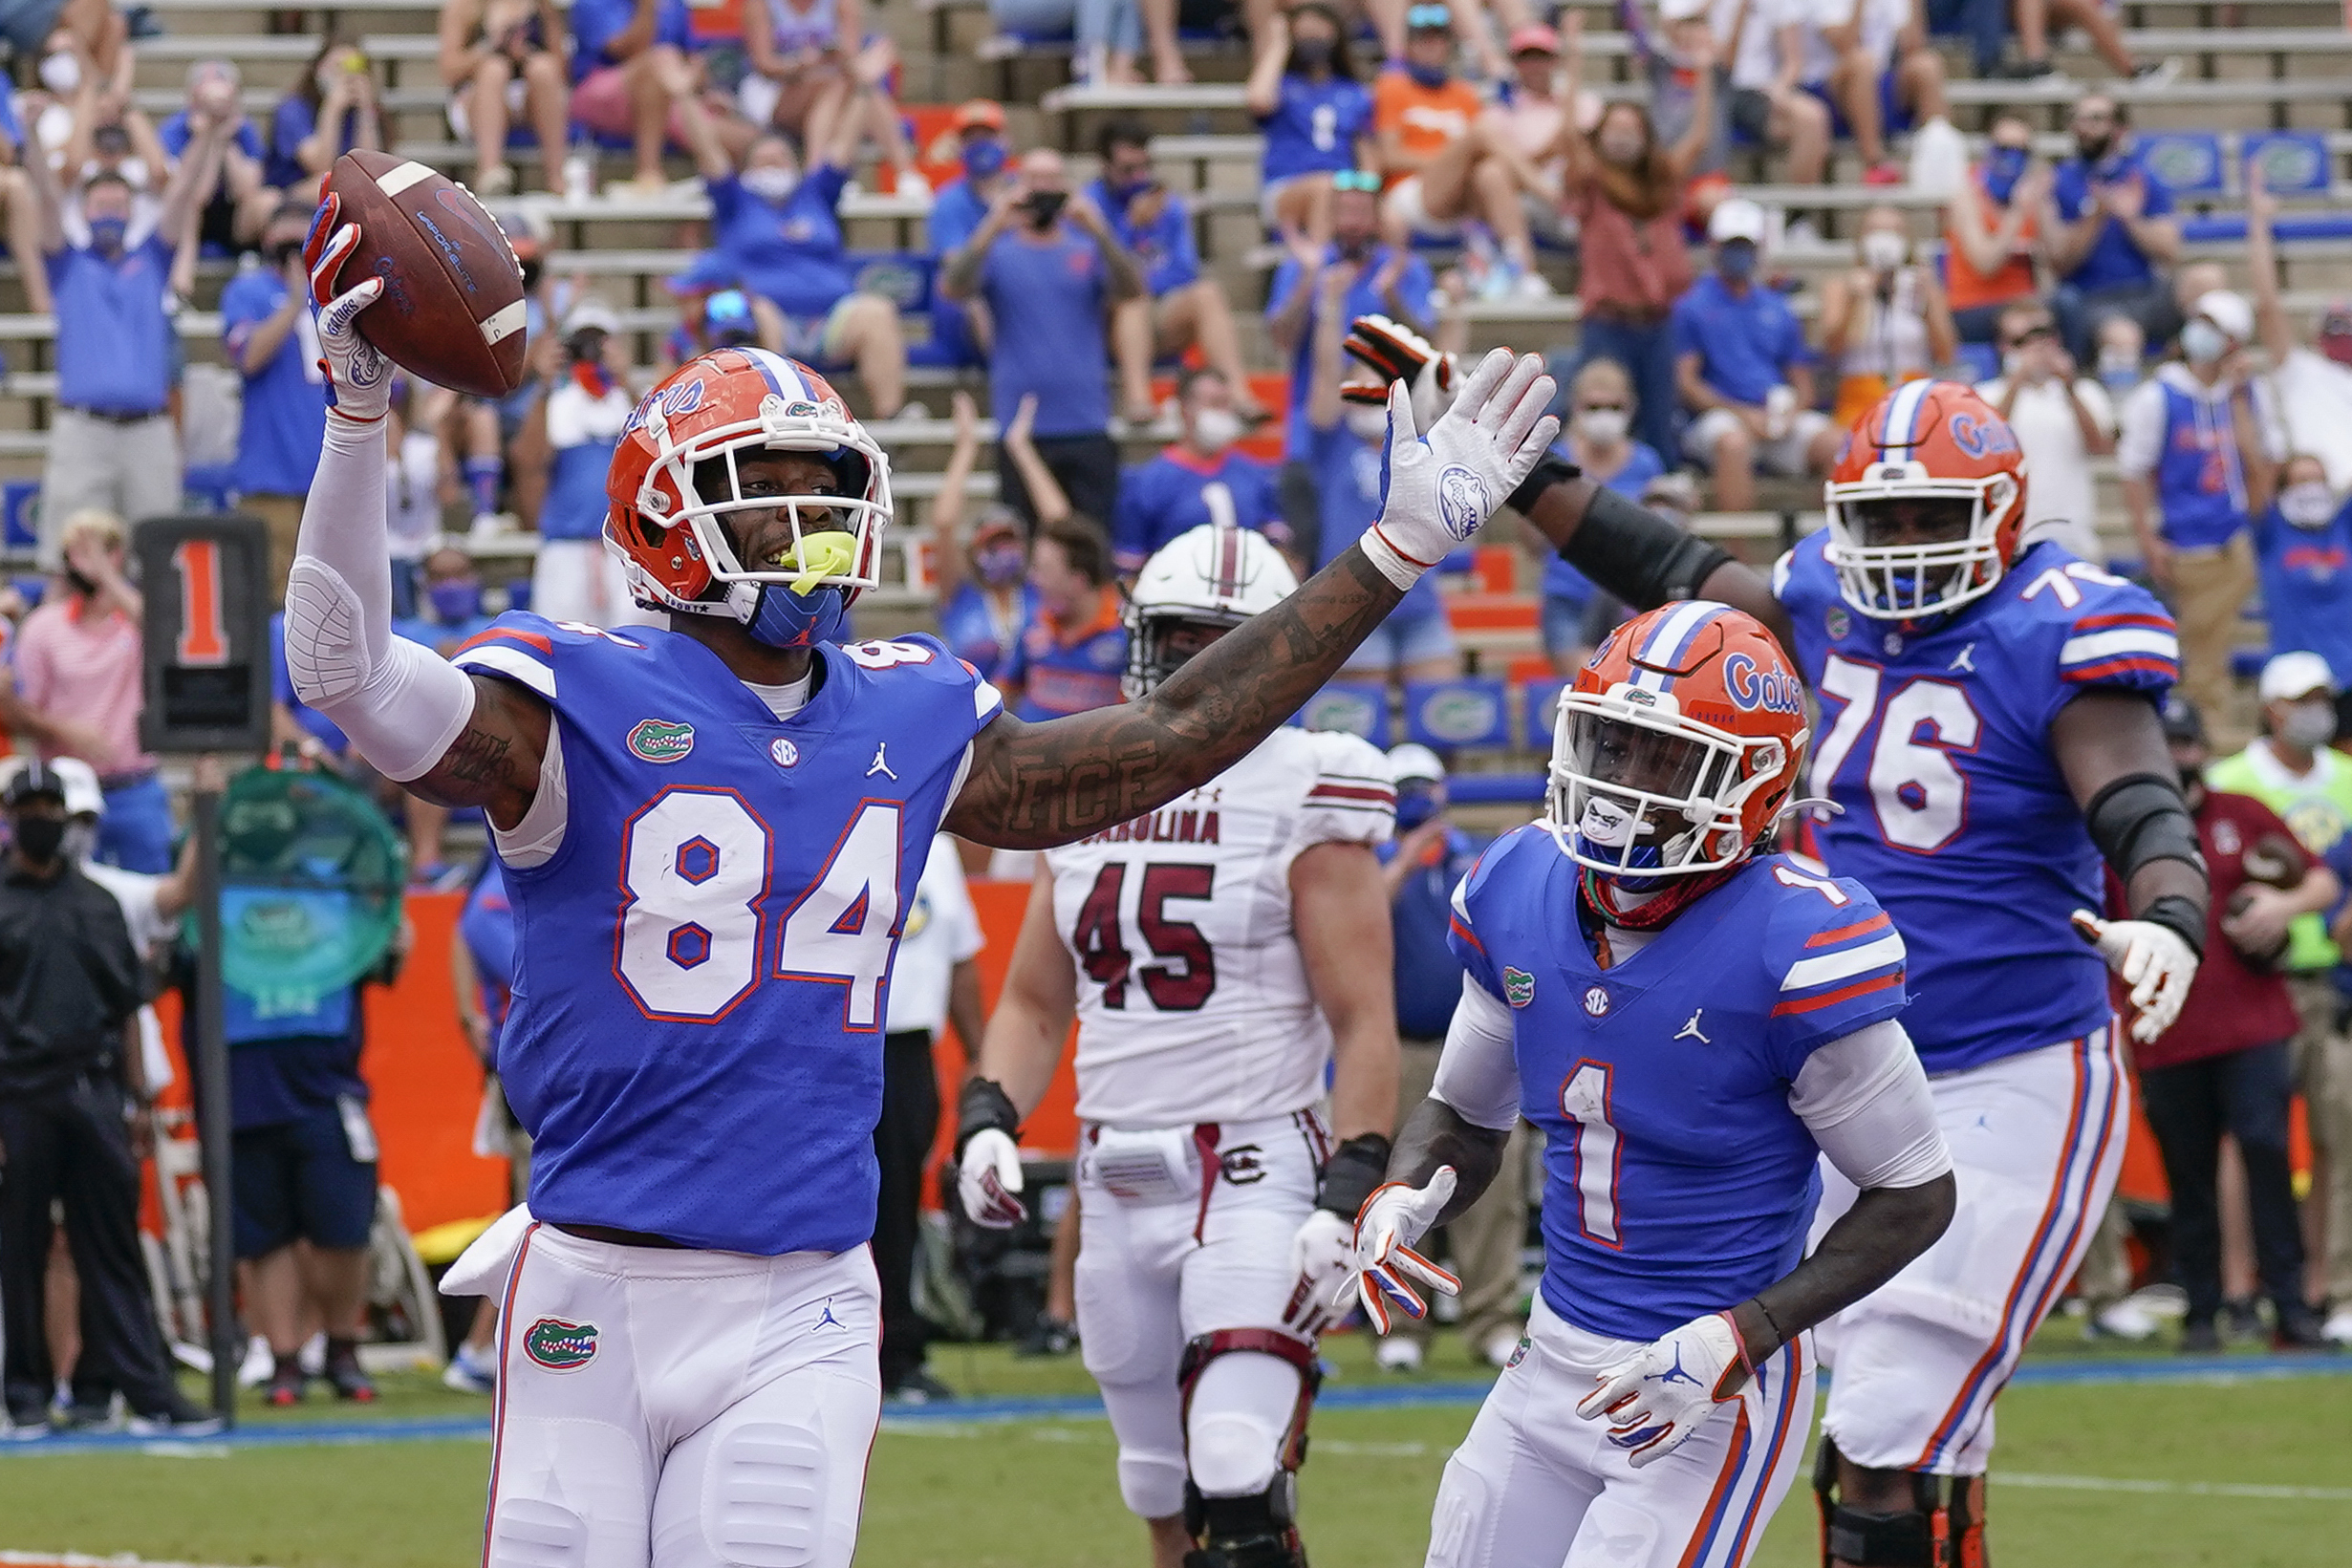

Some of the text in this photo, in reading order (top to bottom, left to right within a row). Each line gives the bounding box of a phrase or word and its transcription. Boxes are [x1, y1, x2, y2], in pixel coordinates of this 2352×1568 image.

[326, 298, 359, 335] GATORS
[173, 540, 229, 666] 1
[770, 739, 799, 765] SEC
[1808, 650, 1983, 855] 76
[613, 784, 905, 1033] 84
[1072, 862, 1217, 1013] 45
[1771, 863, 1852, 909] 1
[1585, 988, 1609, 1015] SEC
[1560, 1057, 1623, 1251] 1
